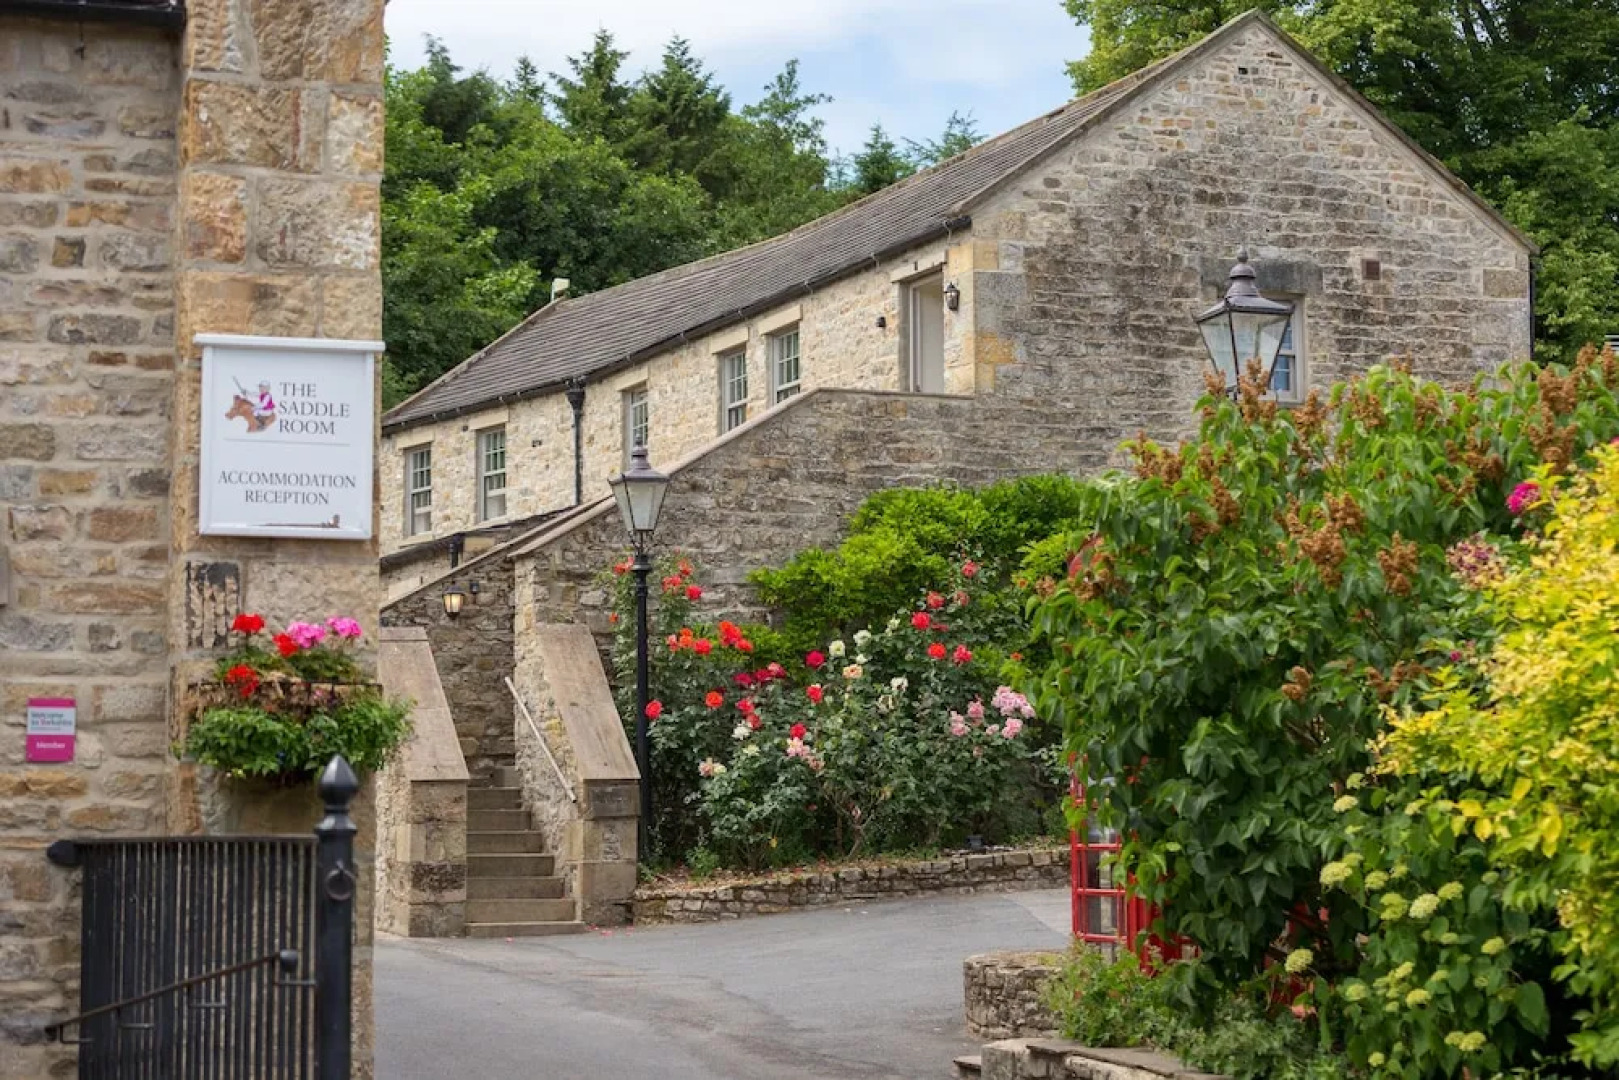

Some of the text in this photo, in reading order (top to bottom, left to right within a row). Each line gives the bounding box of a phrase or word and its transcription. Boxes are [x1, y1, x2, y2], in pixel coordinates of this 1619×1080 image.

[279, 382, 317, 398] THE
[278, 400, 351, 418] SADDLE
[279, 418, 335, 435] ROOM
[218, 470, 356, 488] ACCOMMODATION
[245, 490, 329, 505] RECEPTION
